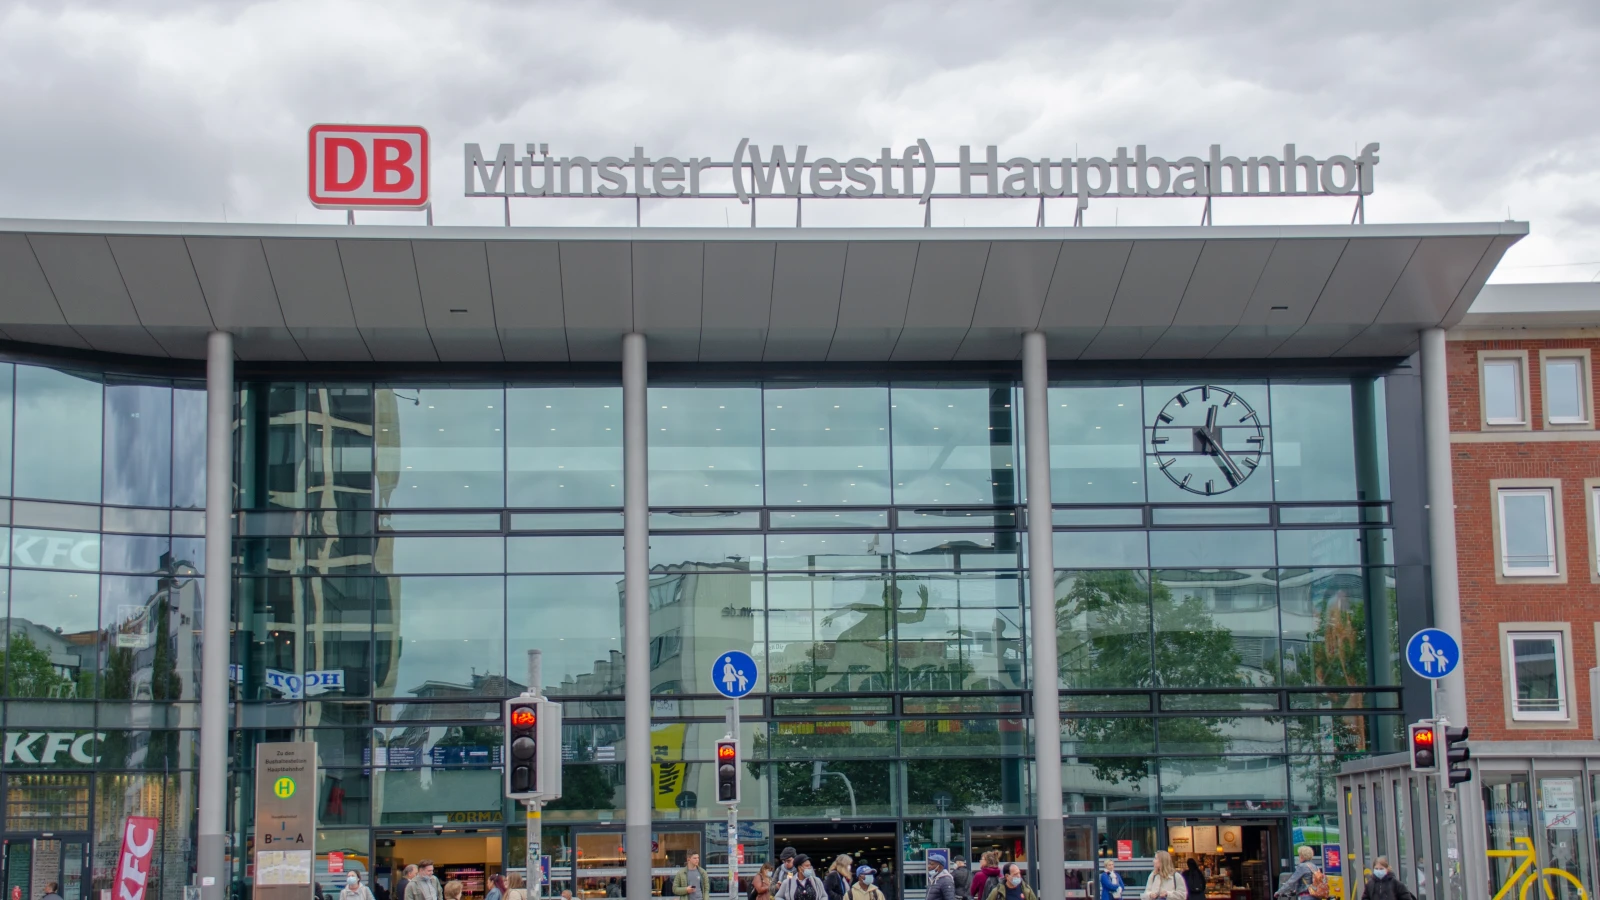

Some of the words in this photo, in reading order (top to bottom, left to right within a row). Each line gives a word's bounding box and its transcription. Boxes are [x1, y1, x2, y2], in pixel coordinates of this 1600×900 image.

[324, 137, 415, 192] DB
[464, 142, 711, 198] Münster
[731, 137, 934, 205] (Westf)
[959, 141, 1380, 210] Hauptbahnhof
[2, 534, 100, 570] KFC
[4, 732, 106, 764] KFC
[278, 780, 291, 795] H
[264, 833, 273, 844] B
[295, 832, 305, 844] A
[118, 822, 154, 900] KFC
